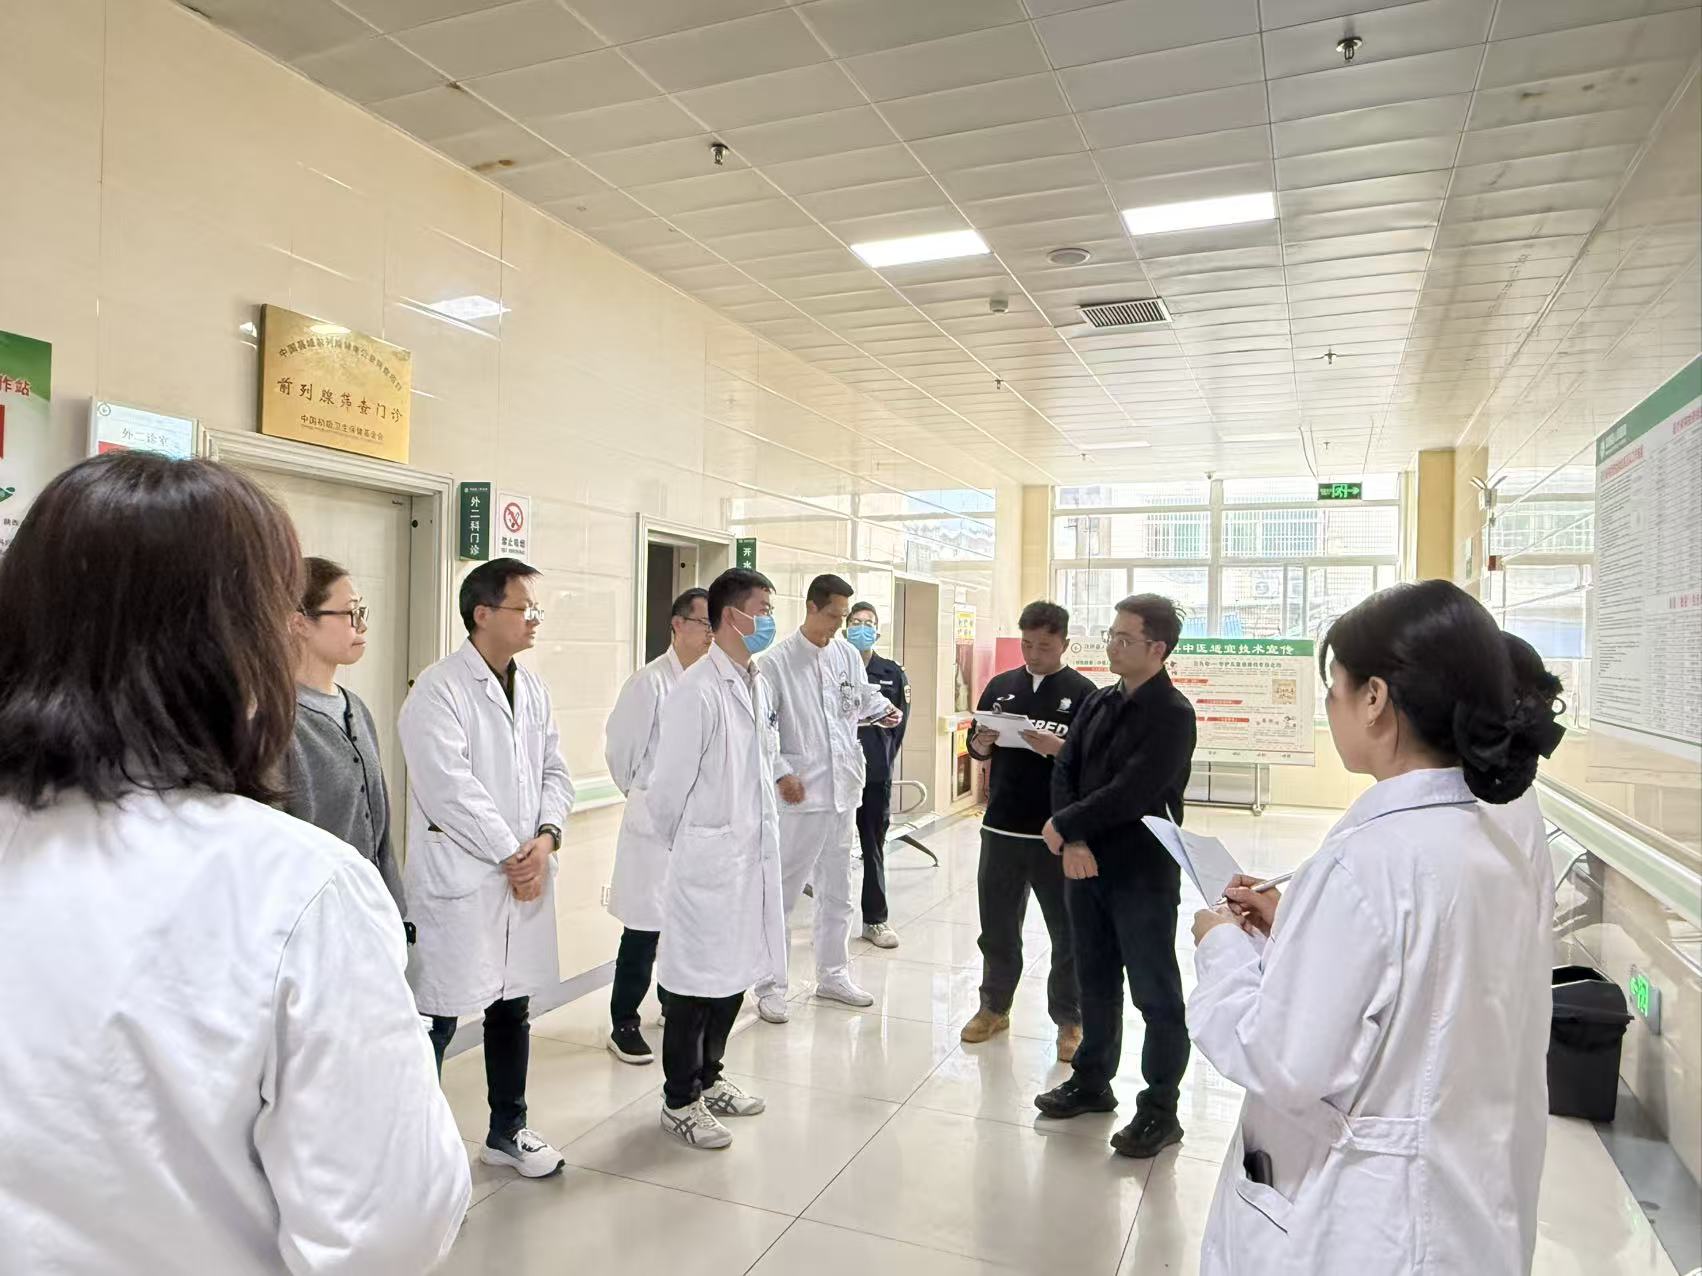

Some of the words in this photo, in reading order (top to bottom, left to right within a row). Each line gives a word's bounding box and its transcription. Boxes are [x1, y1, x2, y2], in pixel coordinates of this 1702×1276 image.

[469, 495, 481, 556] 外二科门诊
